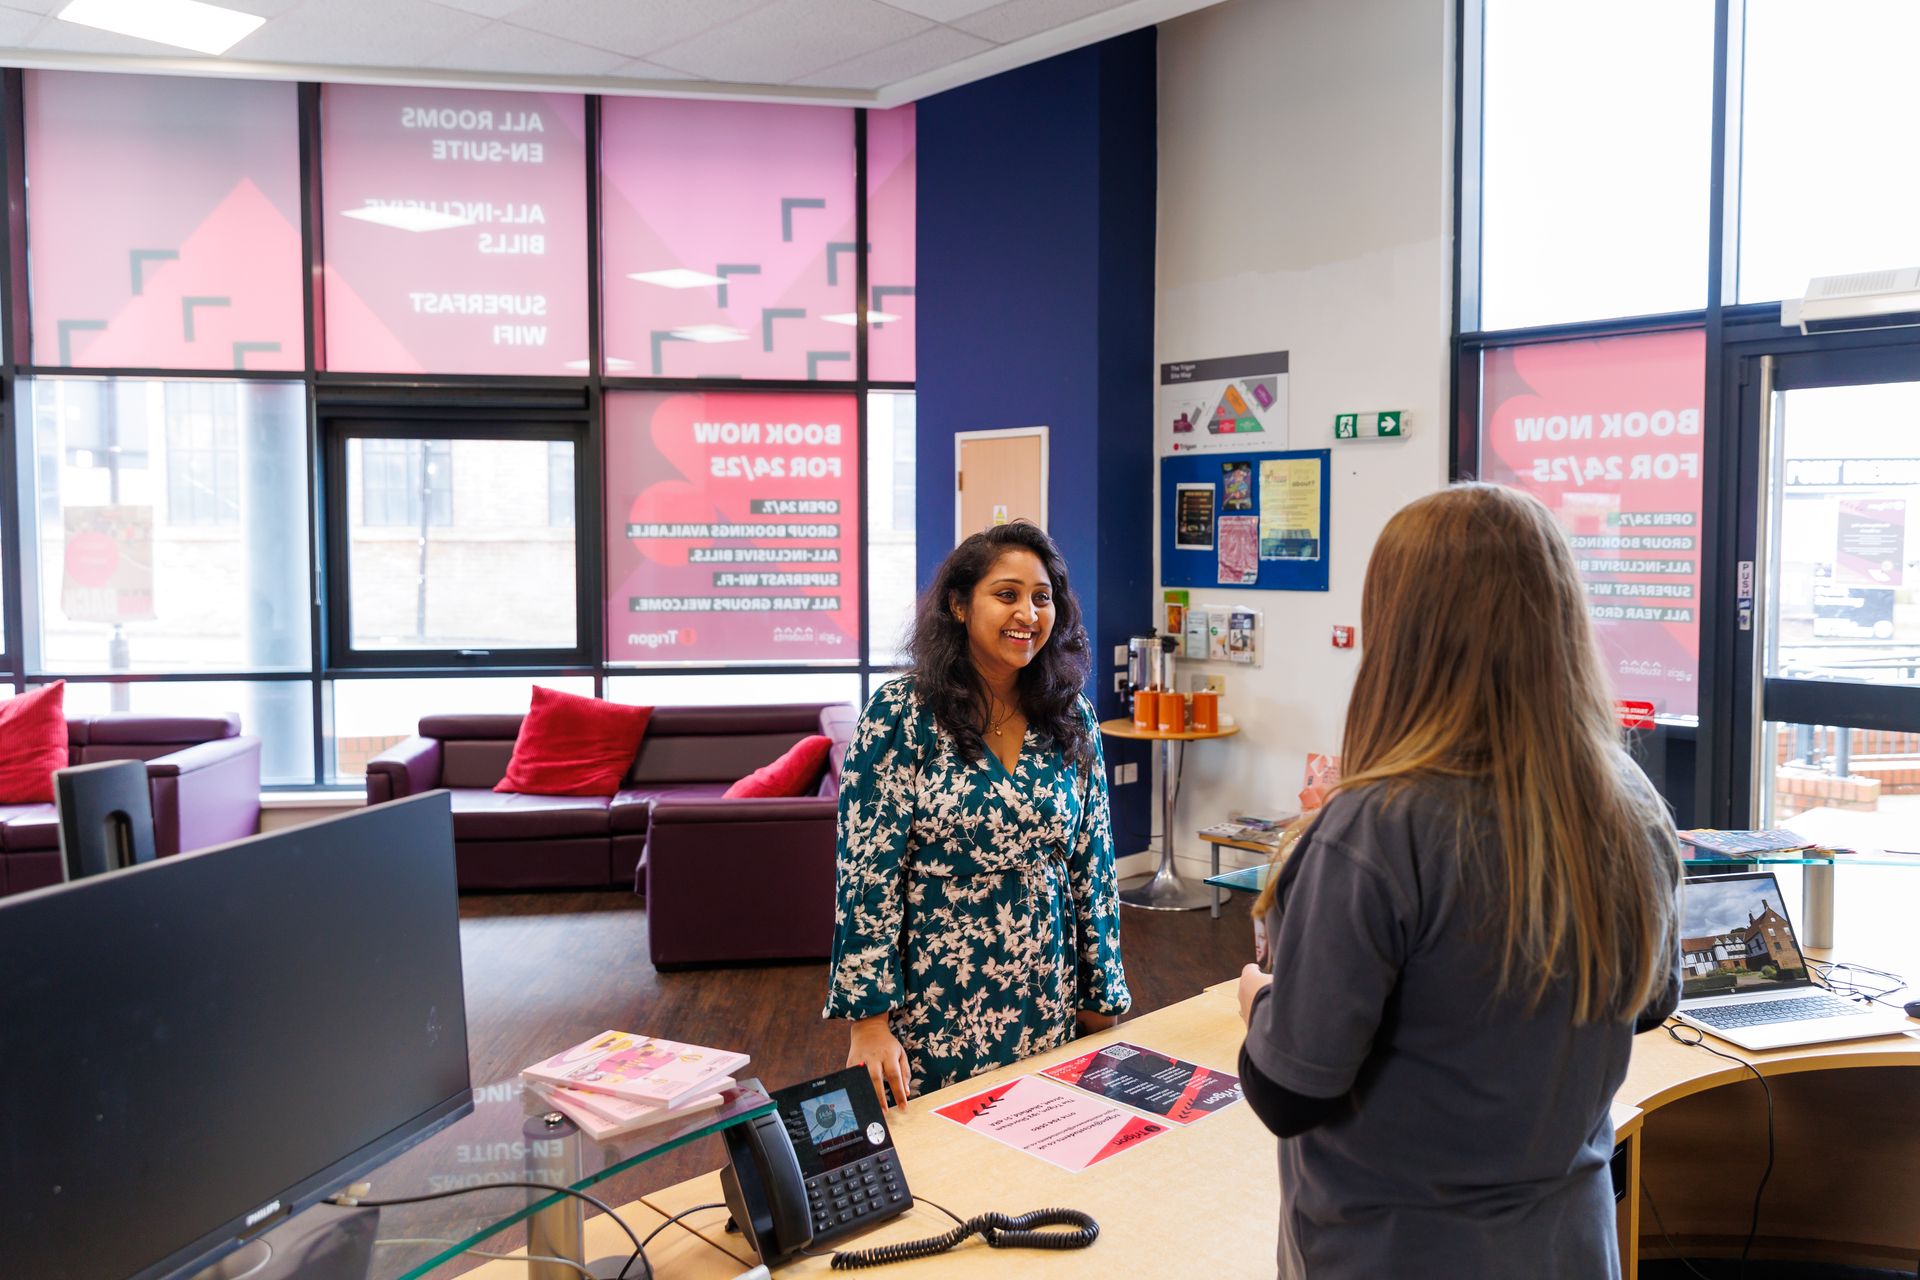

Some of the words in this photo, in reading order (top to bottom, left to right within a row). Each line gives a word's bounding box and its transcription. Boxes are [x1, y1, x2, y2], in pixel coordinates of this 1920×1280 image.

[1741, 562, 1750, 597] PUSH
[1113, 1129, 1150, 1146] Trigon
[246, 1200, 280, 1227] PHILIPS
